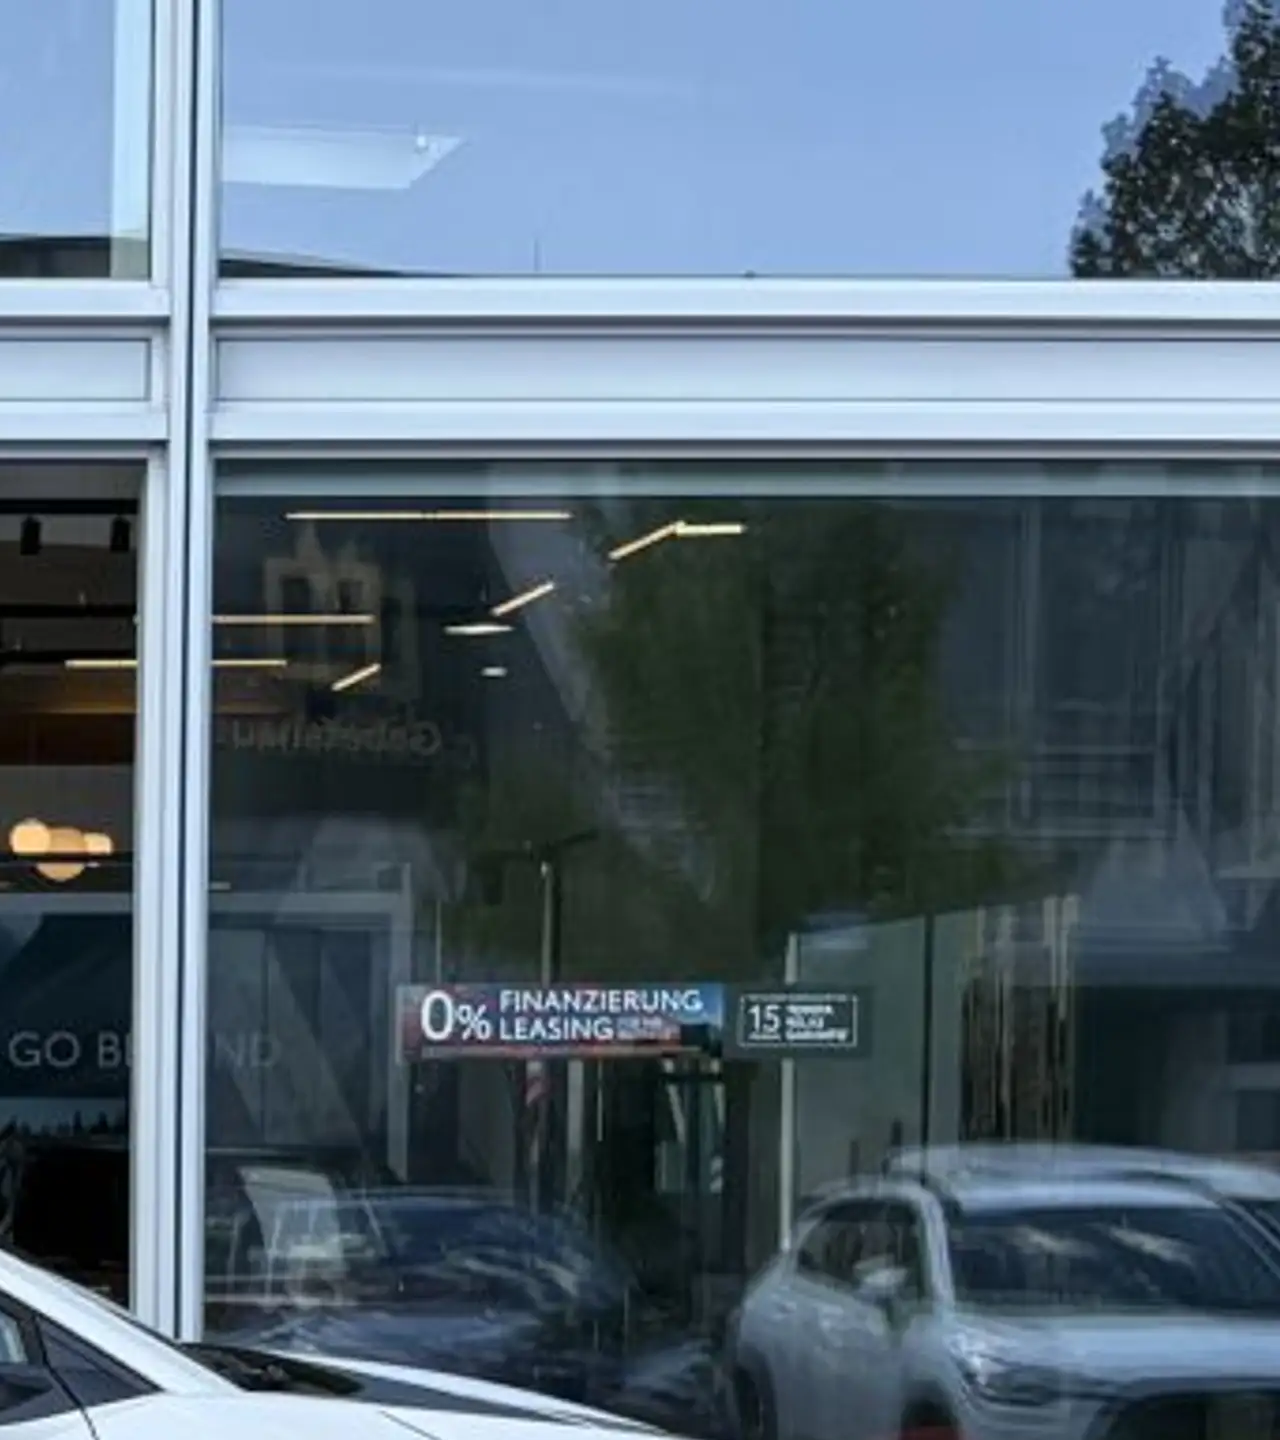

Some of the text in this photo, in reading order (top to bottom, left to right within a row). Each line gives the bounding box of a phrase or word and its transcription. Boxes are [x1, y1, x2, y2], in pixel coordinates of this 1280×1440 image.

[421, 990, 703, 1040] 0% FINANZIERUNG
[500, 1017, 613, 1040] LEASING
[748, 1004, 781, 1033] 15
[8, 1031, 80, 1068] GO
[97, 1031, 282, 1068] BND
